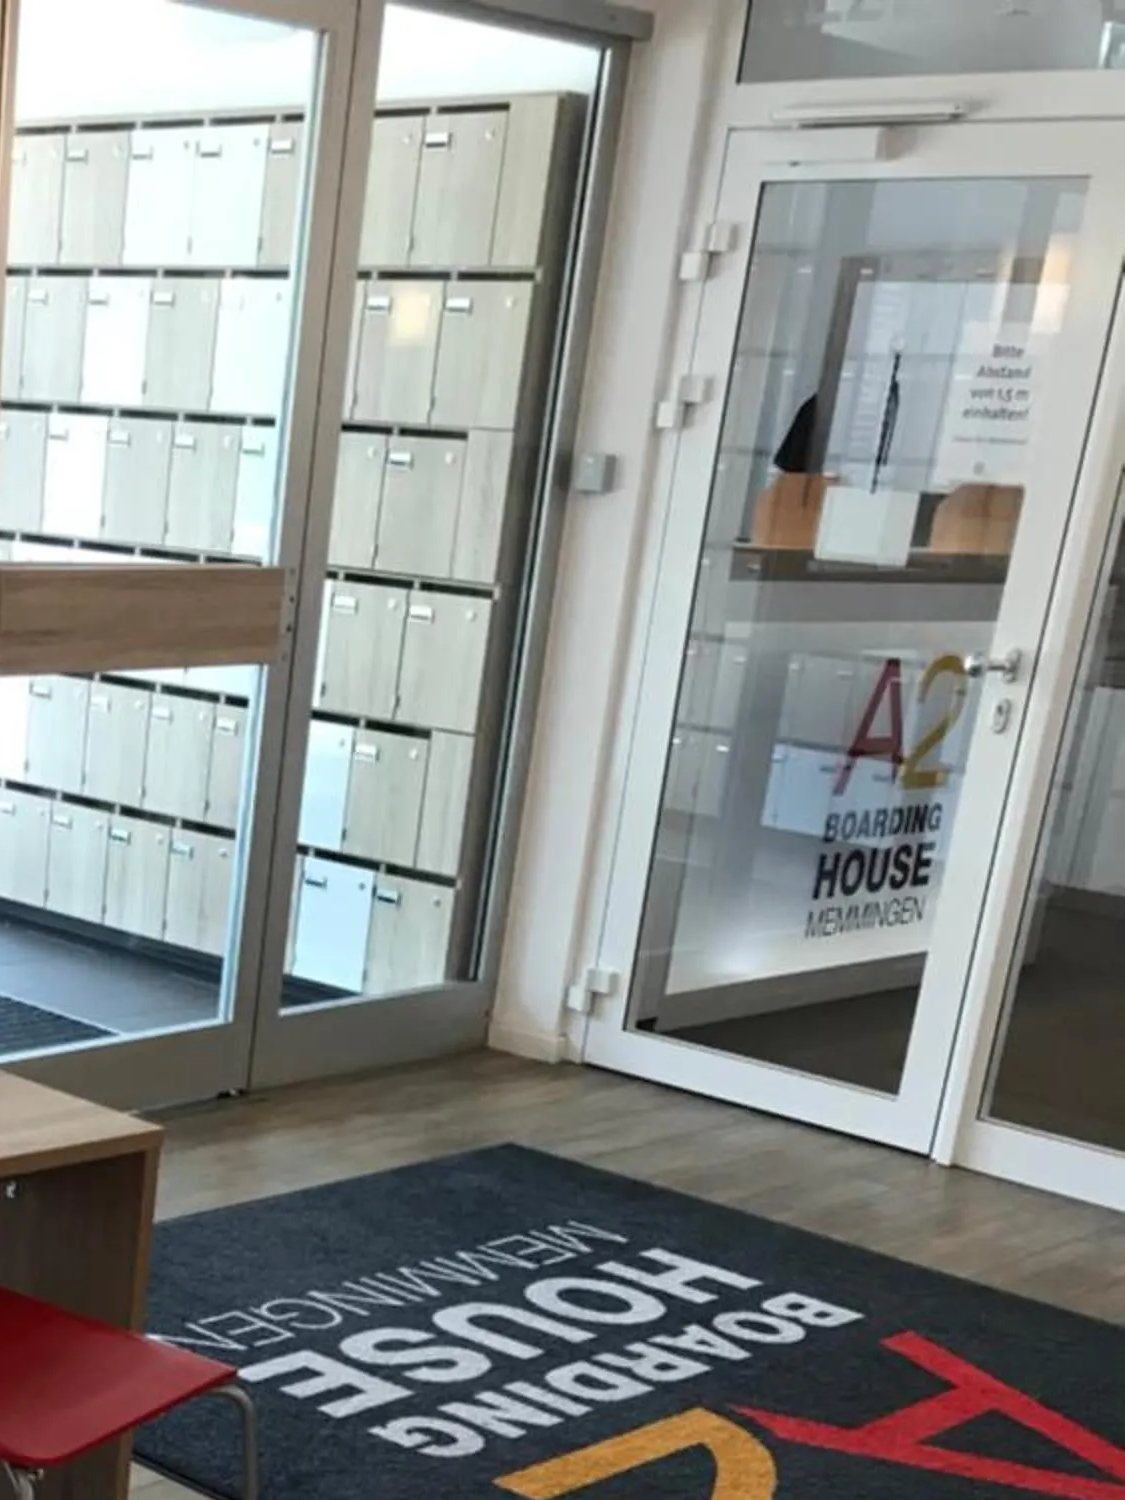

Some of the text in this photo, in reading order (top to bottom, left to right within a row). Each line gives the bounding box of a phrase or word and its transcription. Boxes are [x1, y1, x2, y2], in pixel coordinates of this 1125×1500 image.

[977, 365, 1032, 379] Abstand
[992, 344, 1024, 359] Bitte
[832, 655, 967, 796] A2
[824, 803, 942, 842] BOARDING
[813, 843, 935, 900] HOUSE
[805, 896, 924, 938] MEMMINGEN
[237, 1248, 764, 1418] HOUSE
[368, 1292, 865, 1457] BOARDING
